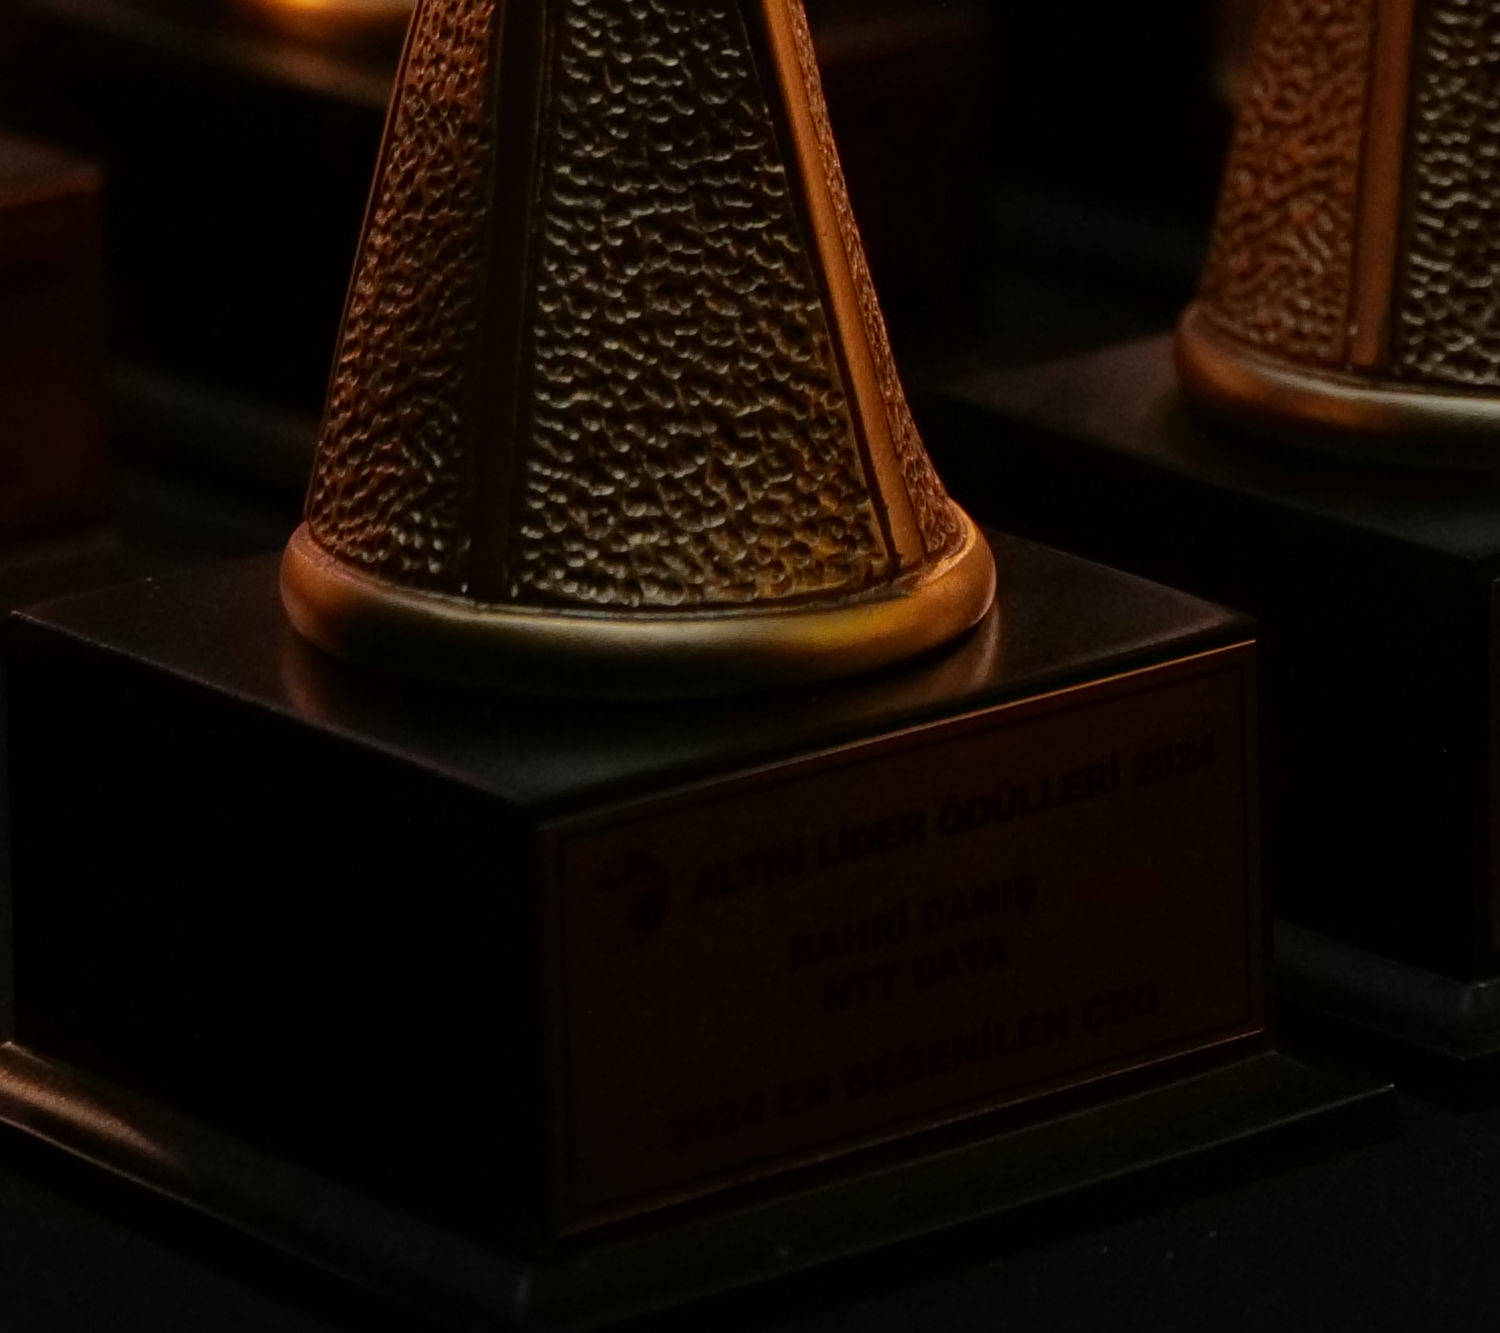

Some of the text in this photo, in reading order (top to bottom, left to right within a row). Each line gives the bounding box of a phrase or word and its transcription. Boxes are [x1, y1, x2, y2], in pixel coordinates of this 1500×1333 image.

[690, 733, 1217, 905] ALTIN LİDER ÖDÜLLERİ 2024
[790, 874, 1038, 971] BAHRİ DANIŞ
[822, 935, 1009, 1014] NTT DATA
[669, 981, 1161, 1151] 2024 EN BEĞENİLEN CEO
